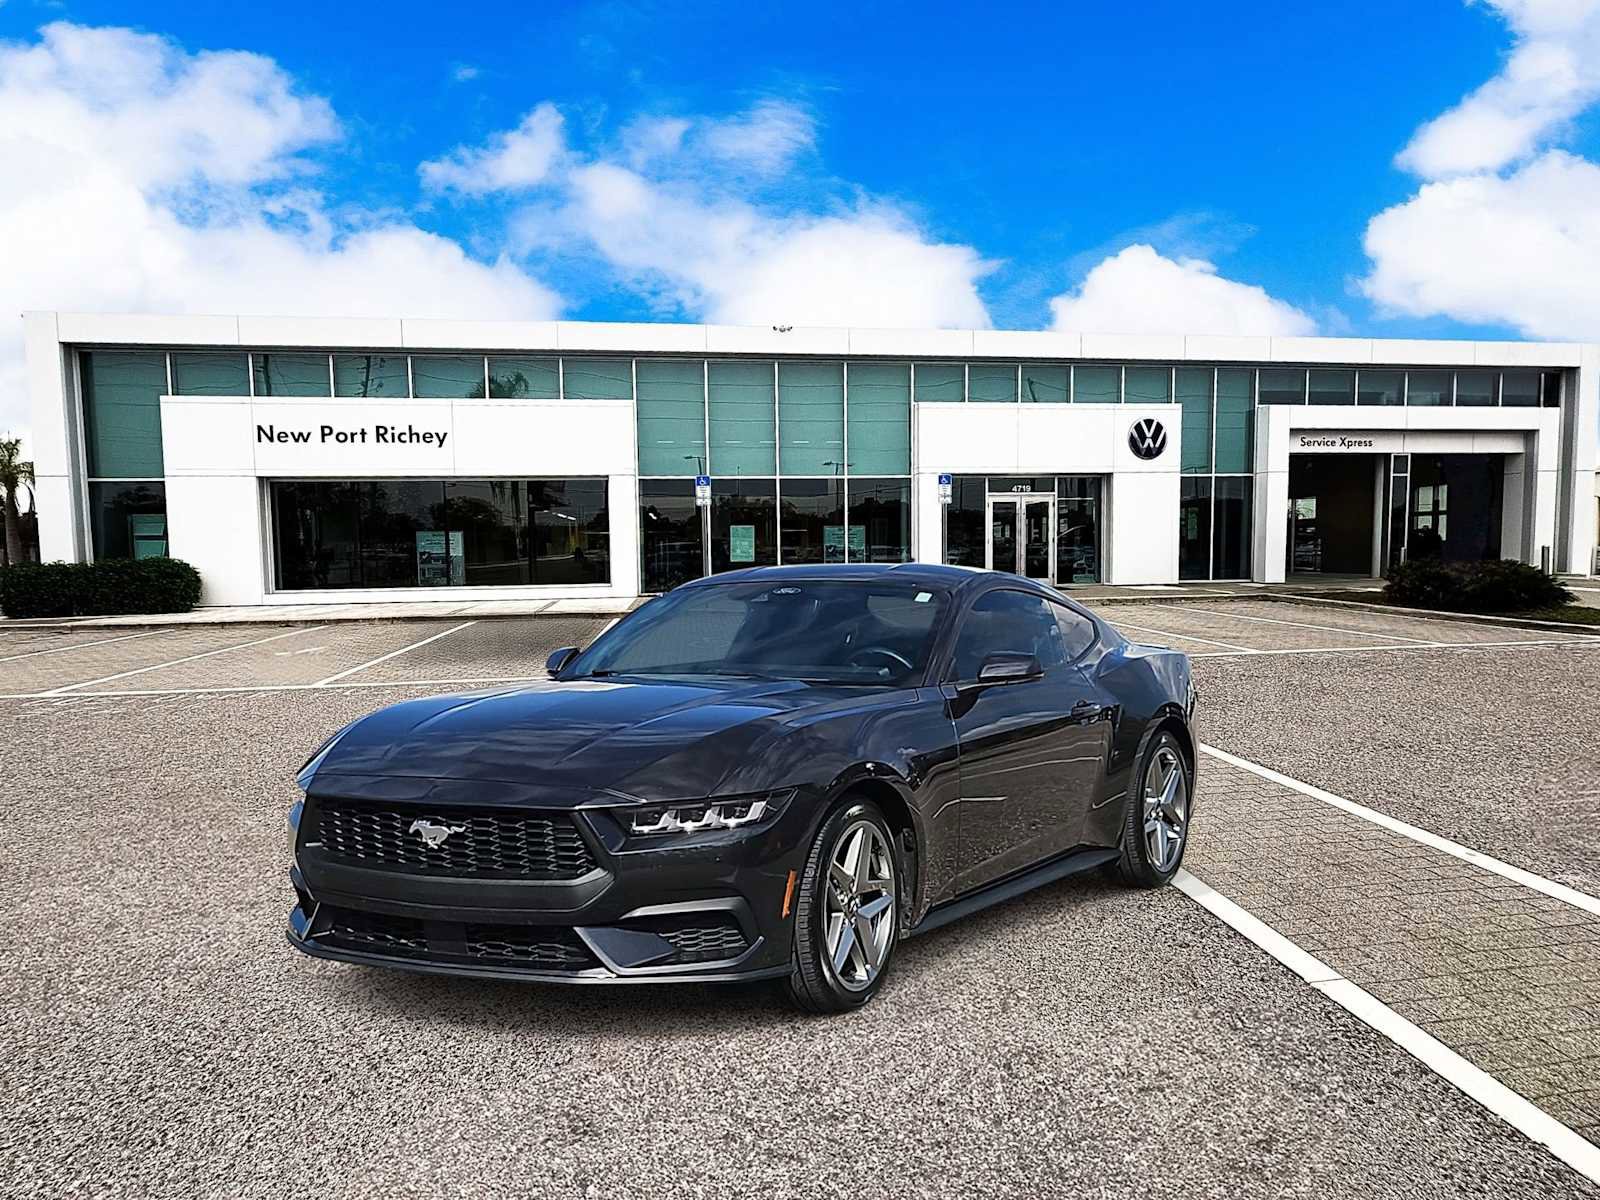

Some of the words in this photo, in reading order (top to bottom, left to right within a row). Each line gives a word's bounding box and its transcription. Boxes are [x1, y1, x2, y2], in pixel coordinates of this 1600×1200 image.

[256, 424, 312, 443] New
[320, 425, 367, 443] Port
[375, 424, 448, 448] Richey
[1300, 436, 1336, 447] Service
[1339, 436, 1373, 449] Xpress
[1011, 484, 1032, 492] 4719
